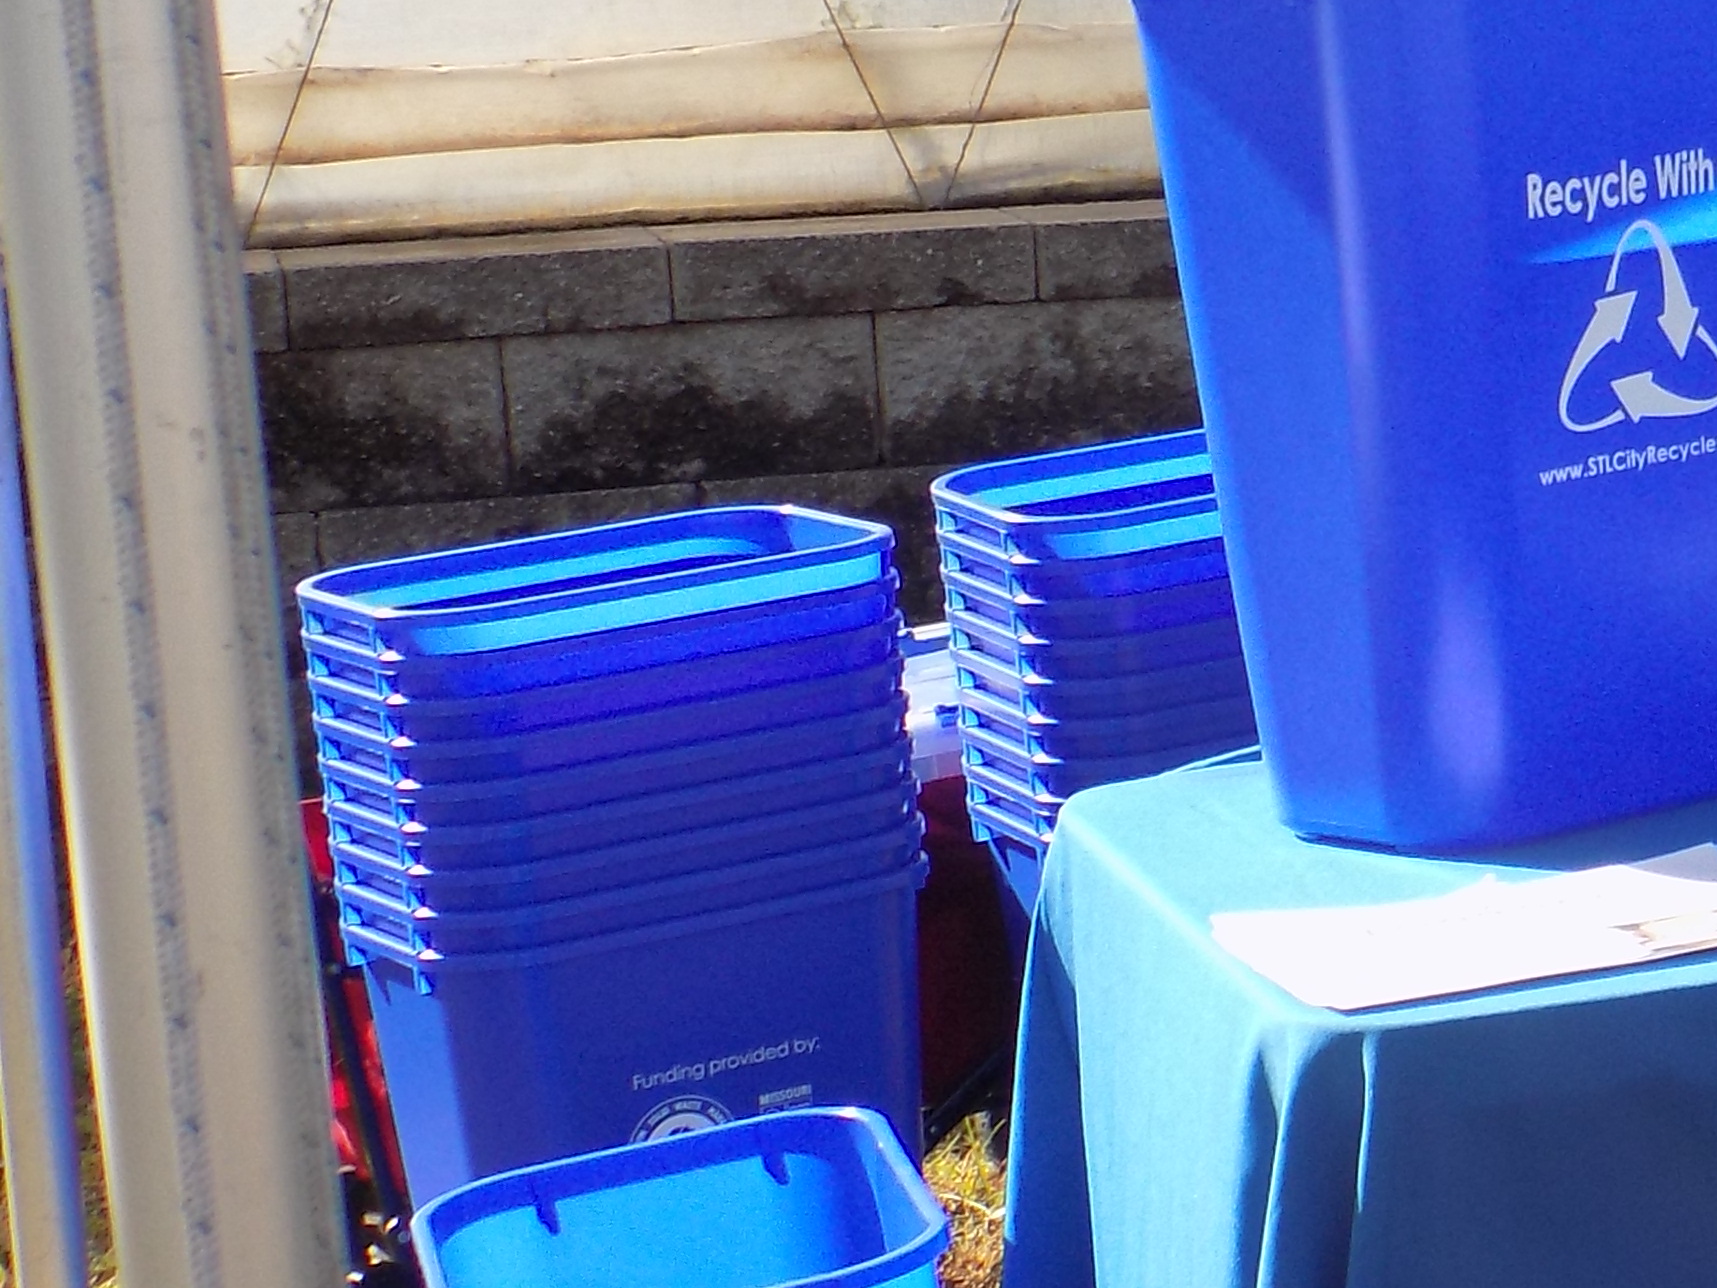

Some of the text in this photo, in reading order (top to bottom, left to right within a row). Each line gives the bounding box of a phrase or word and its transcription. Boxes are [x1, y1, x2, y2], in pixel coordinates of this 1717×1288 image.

[1526, 158, 1648, 223] Recycle
[1653, 147, 1715, 200] With
[632, 1061, 706, 1091] Funding
[708, 1040, 790, 1078] provided
